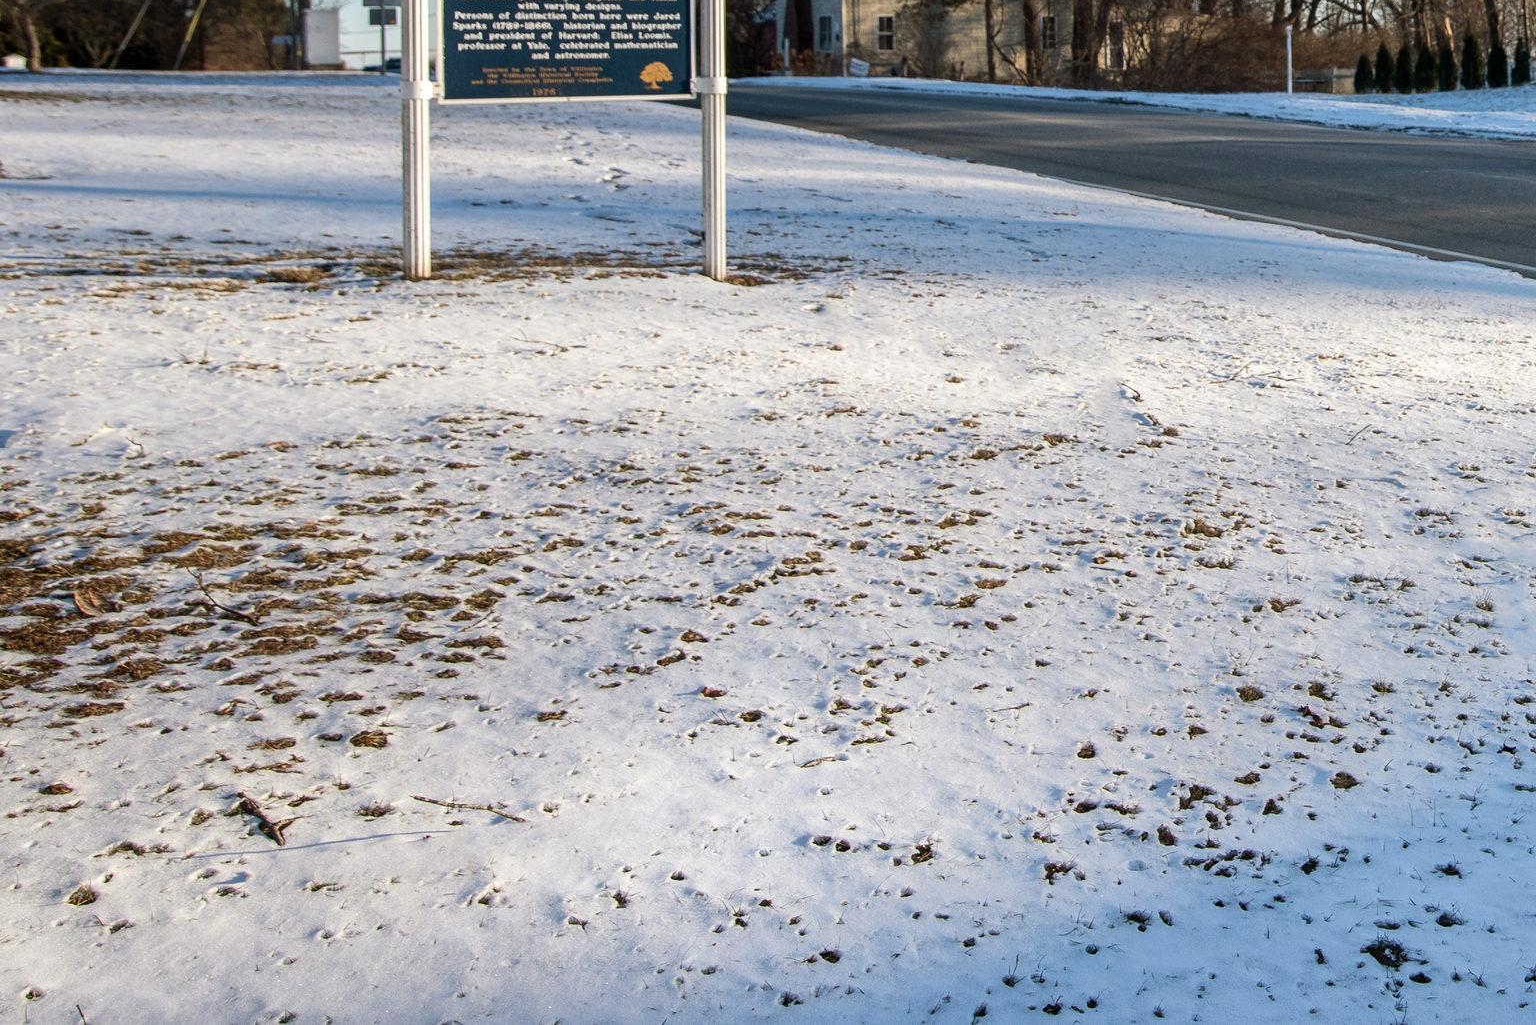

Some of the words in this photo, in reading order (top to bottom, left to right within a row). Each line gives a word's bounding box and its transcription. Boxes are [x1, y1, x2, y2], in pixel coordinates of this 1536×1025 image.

[544, 3, 580, 12] varying
[585, 3, 622, 11] designs.
[454, 11, 494, 20] Persons
[498, 12, 510, 20] of
[514, 12, 567, 20] distinction
[452, 22, 487, 31] Sparks
[631, 22, 682, 30] biographer
[463, 32, 483, 40] and
[541, 32, 553, 40] of
